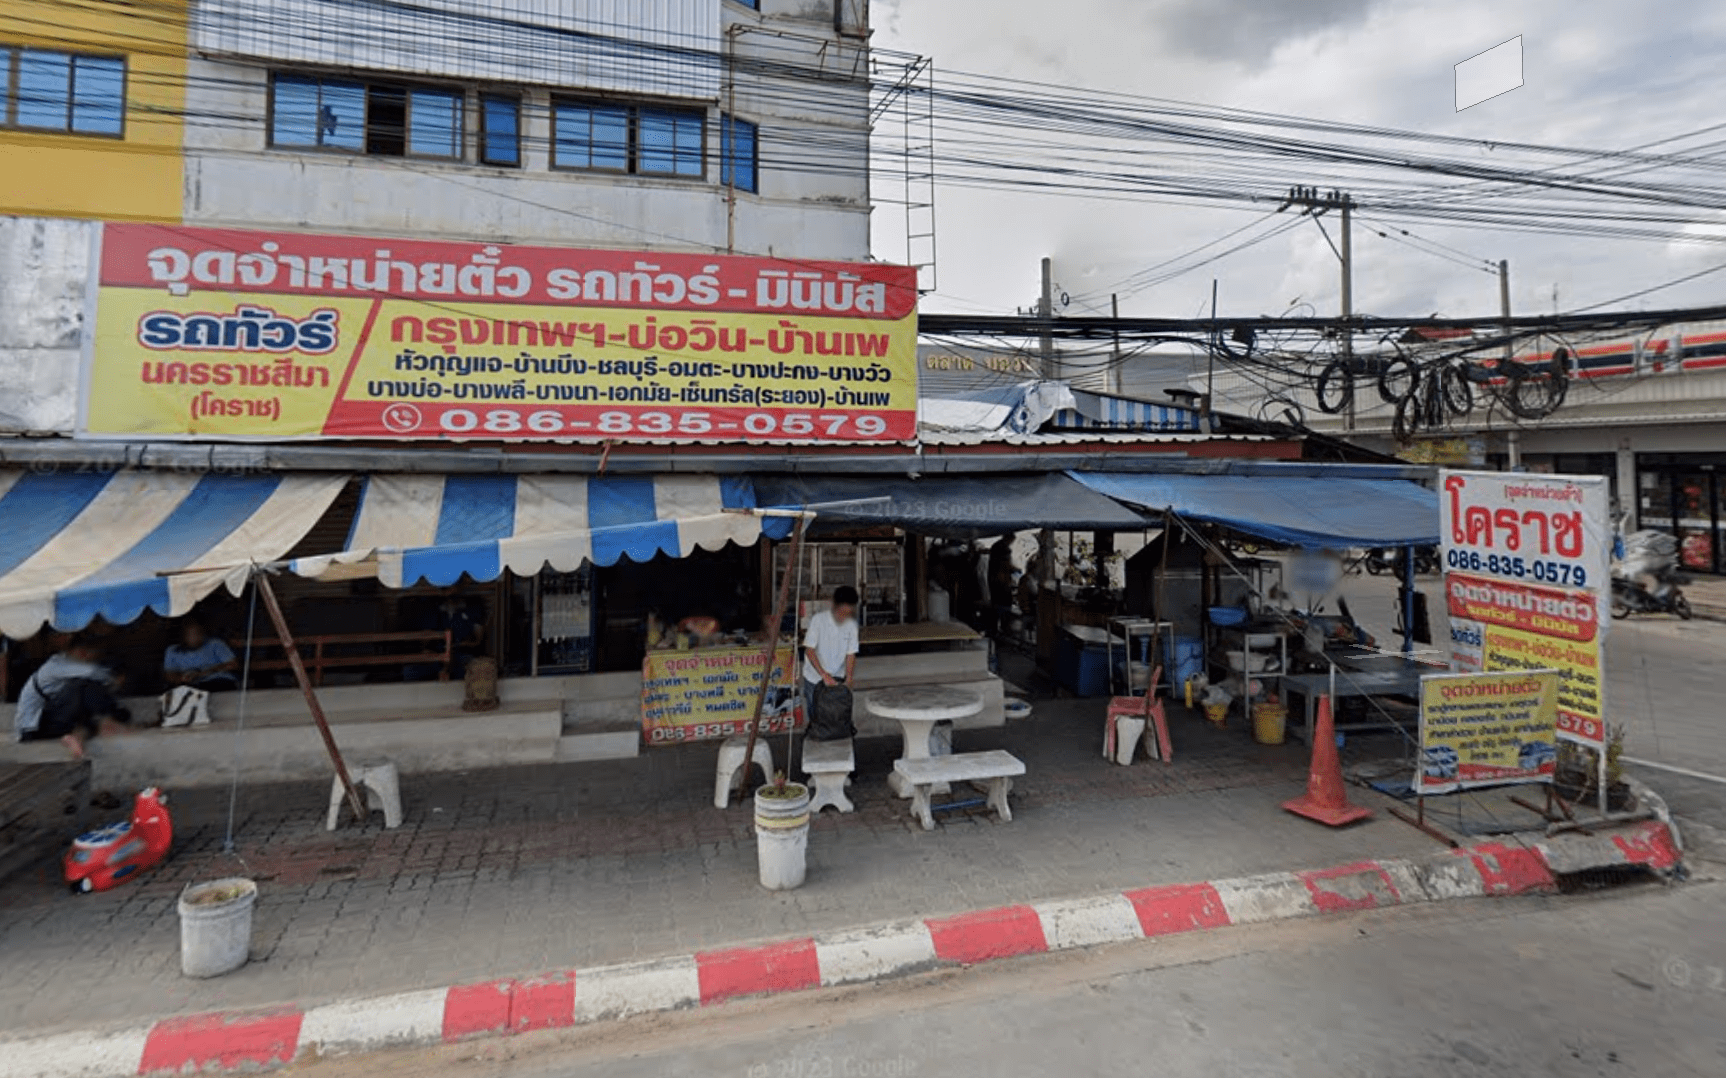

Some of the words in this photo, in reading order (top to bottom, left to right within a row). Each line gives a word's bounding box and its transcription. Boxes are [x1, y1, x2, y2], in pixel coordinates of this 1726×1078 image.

[147, 242, 532, 297] จุดจำหน่ายตั๋ว
[547, 261, 720, 304] รถทัวร์
[757, 270, 886, 313] มินิบัส
[139, 306, 339, 352] รถทัวร์
[140, 356, 330, 389] นครราชสีมา
[190, 391, 281, 421] (โคราช)
[438, 408, 888, 436] 086-835-0579
[1445, 475, 1585, 559] โคราช
[1448, 549, 1587, 588] 086-835-0579
